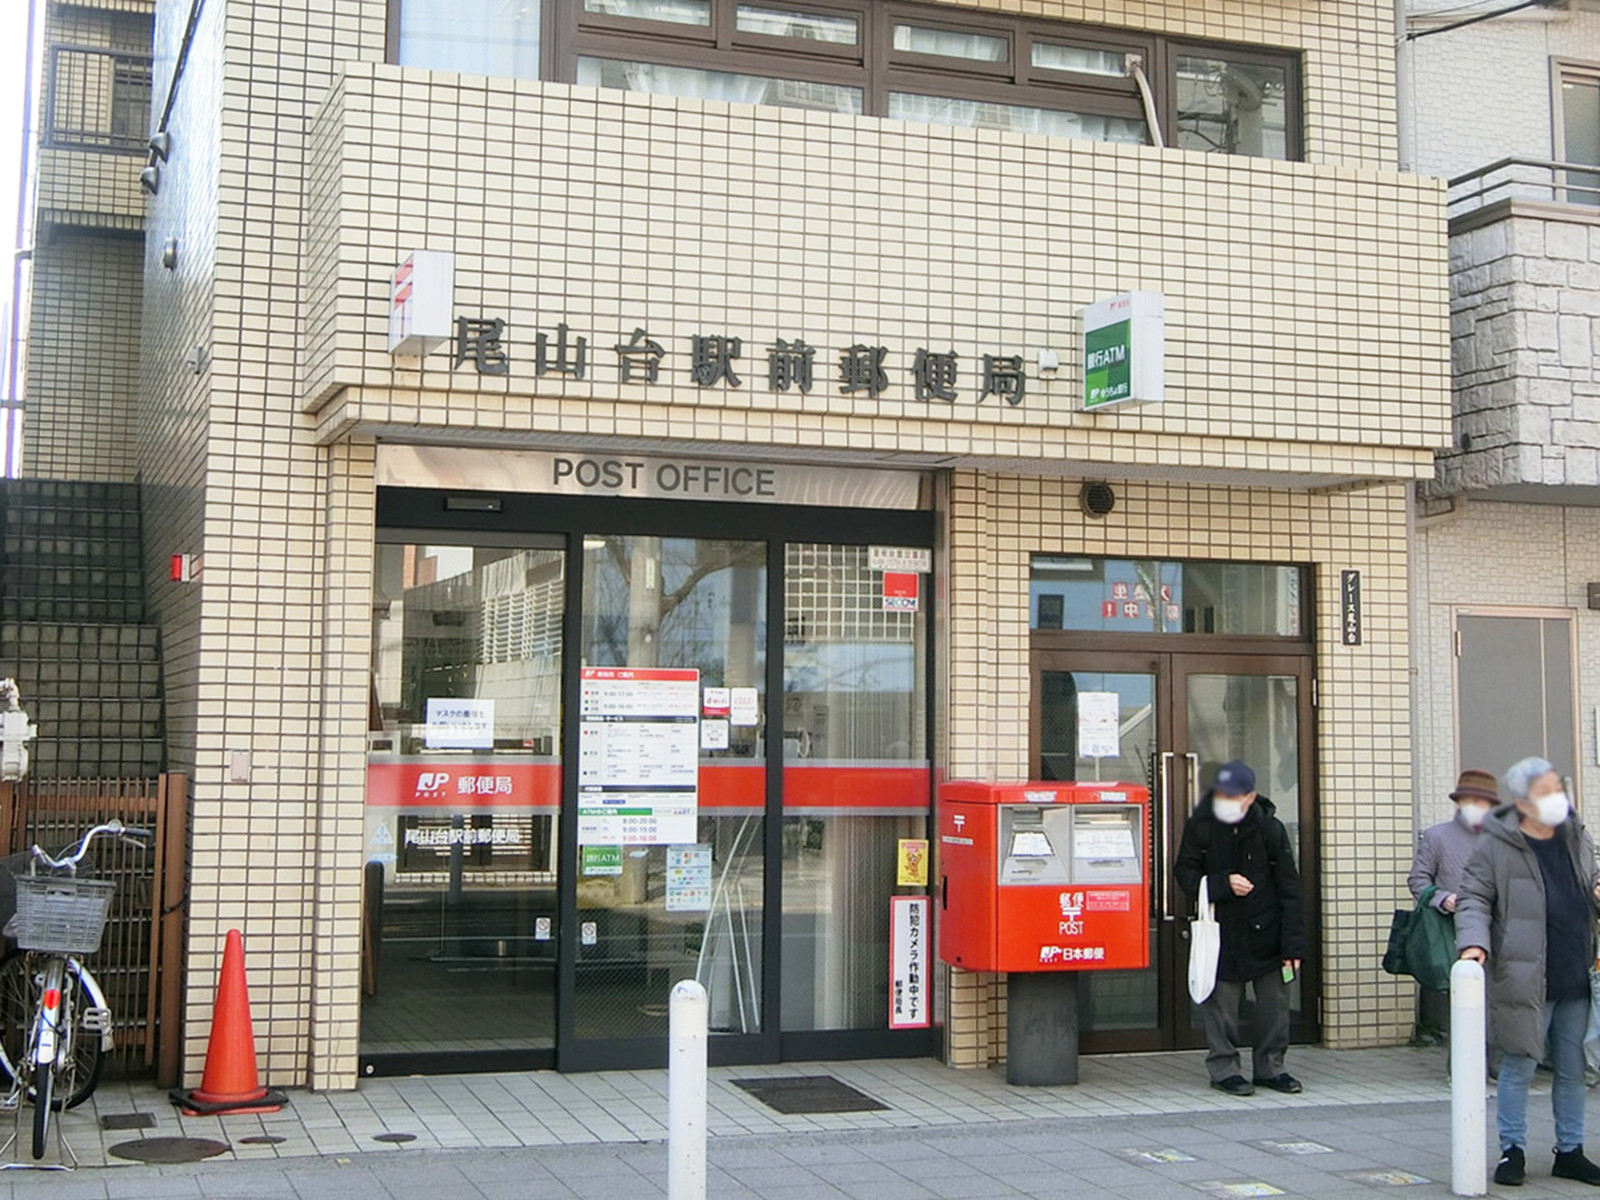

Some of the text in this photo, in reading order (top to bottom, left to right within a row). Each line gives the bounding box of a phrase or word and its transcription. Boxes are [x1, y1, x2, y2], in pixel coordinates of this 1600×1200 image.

[454, 315, 1027, 406] 尾山台駅前郵便局
[553, 457, 775, 497] POST OFFICE
[458, 776, 513, 795] 郵便局
[404, 828, 522, 844] 尾山台駅前郵便局
[1060, 892, 1084, 909] 郵便
[1059, 921, 1084, 935] POST
[909, 903, 920, 1019] 防犯カメラ作動中です
[1063, 947, 1104, 960] 日本郵便
